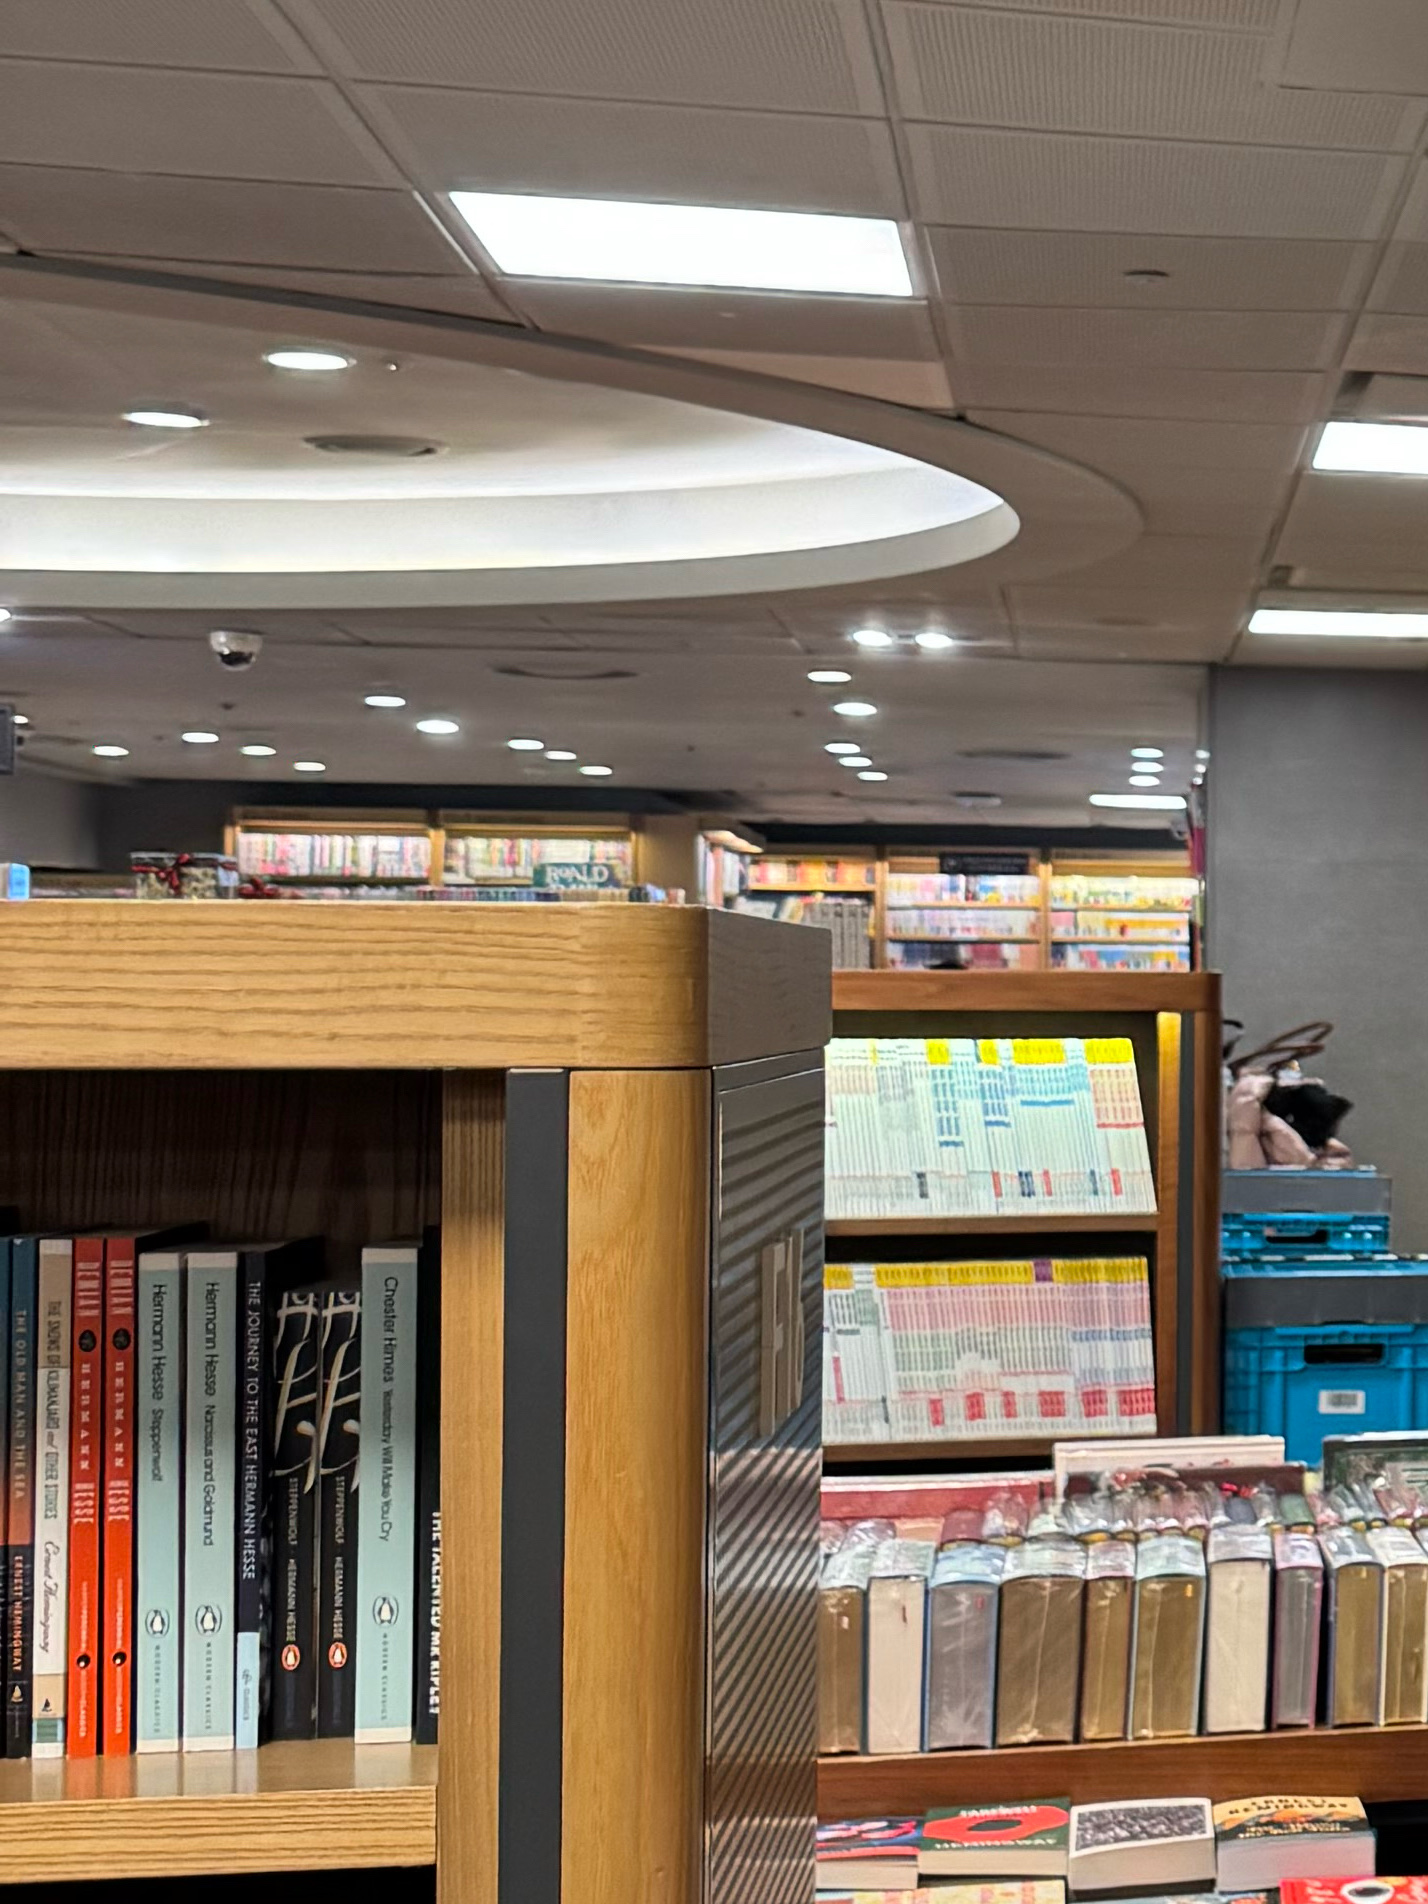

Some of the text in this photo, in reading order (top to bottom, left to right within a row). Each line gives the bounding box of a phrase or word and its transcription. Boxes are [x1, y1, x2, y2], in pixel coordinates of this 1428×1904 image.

[544, 862, 611, 888] ROALD
[151, 1283, 168, 1352] Hermann
[151, 1354, 168, 1402] Hesse
[242, 1280, 262, 1581] THE JOURNEY TO THE EAST HERMANN HESSE
